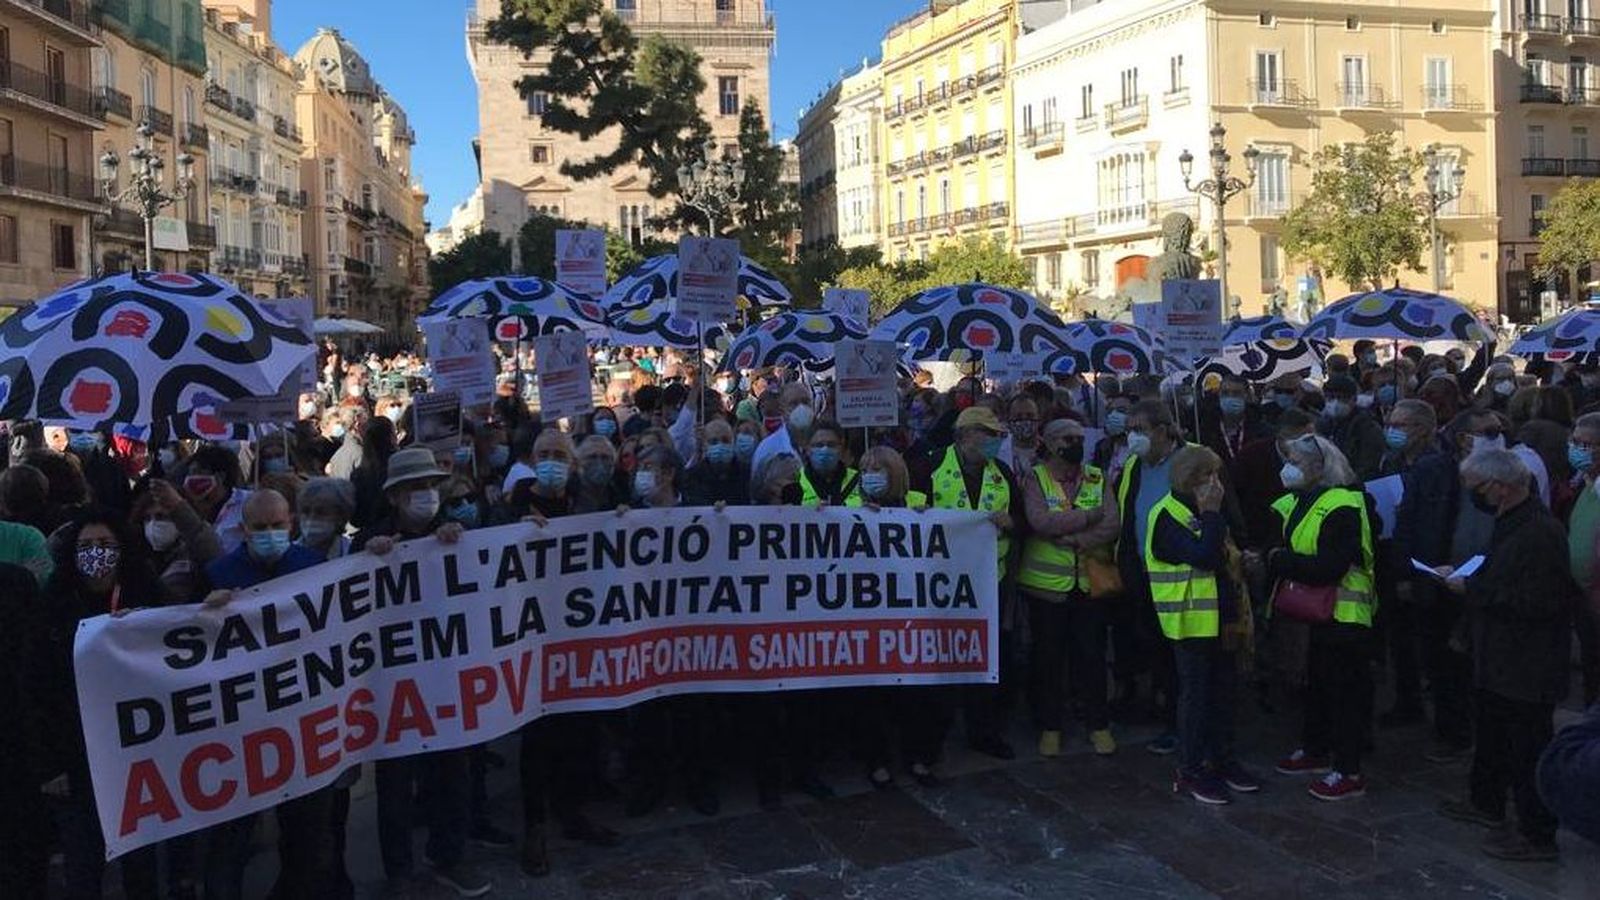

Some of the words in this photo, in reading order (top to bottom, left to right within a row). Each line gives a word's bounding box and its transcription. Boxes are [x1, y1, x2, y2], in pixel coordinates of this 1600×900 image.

[116, 612, 469, 748] DEFENSEM
[489, 596, 546, 648] LA
[563, 575, 770, 629] SANITAT
[785, 564, 978, 611] PÚBLICA
[163, 561, 420, 670] SALVEM
[444, 516, 710, 597] L'ATENCIÓ
[728, 514, 951, 561] PRIMÀRIA
[547, 634, 738, 690] PLATAFORMA
[748, 630, 870, 669] SANITAT
[878, 621, 983, 664] PÚBLICA
[119, 652, 532, 837] ACDESA-PV
